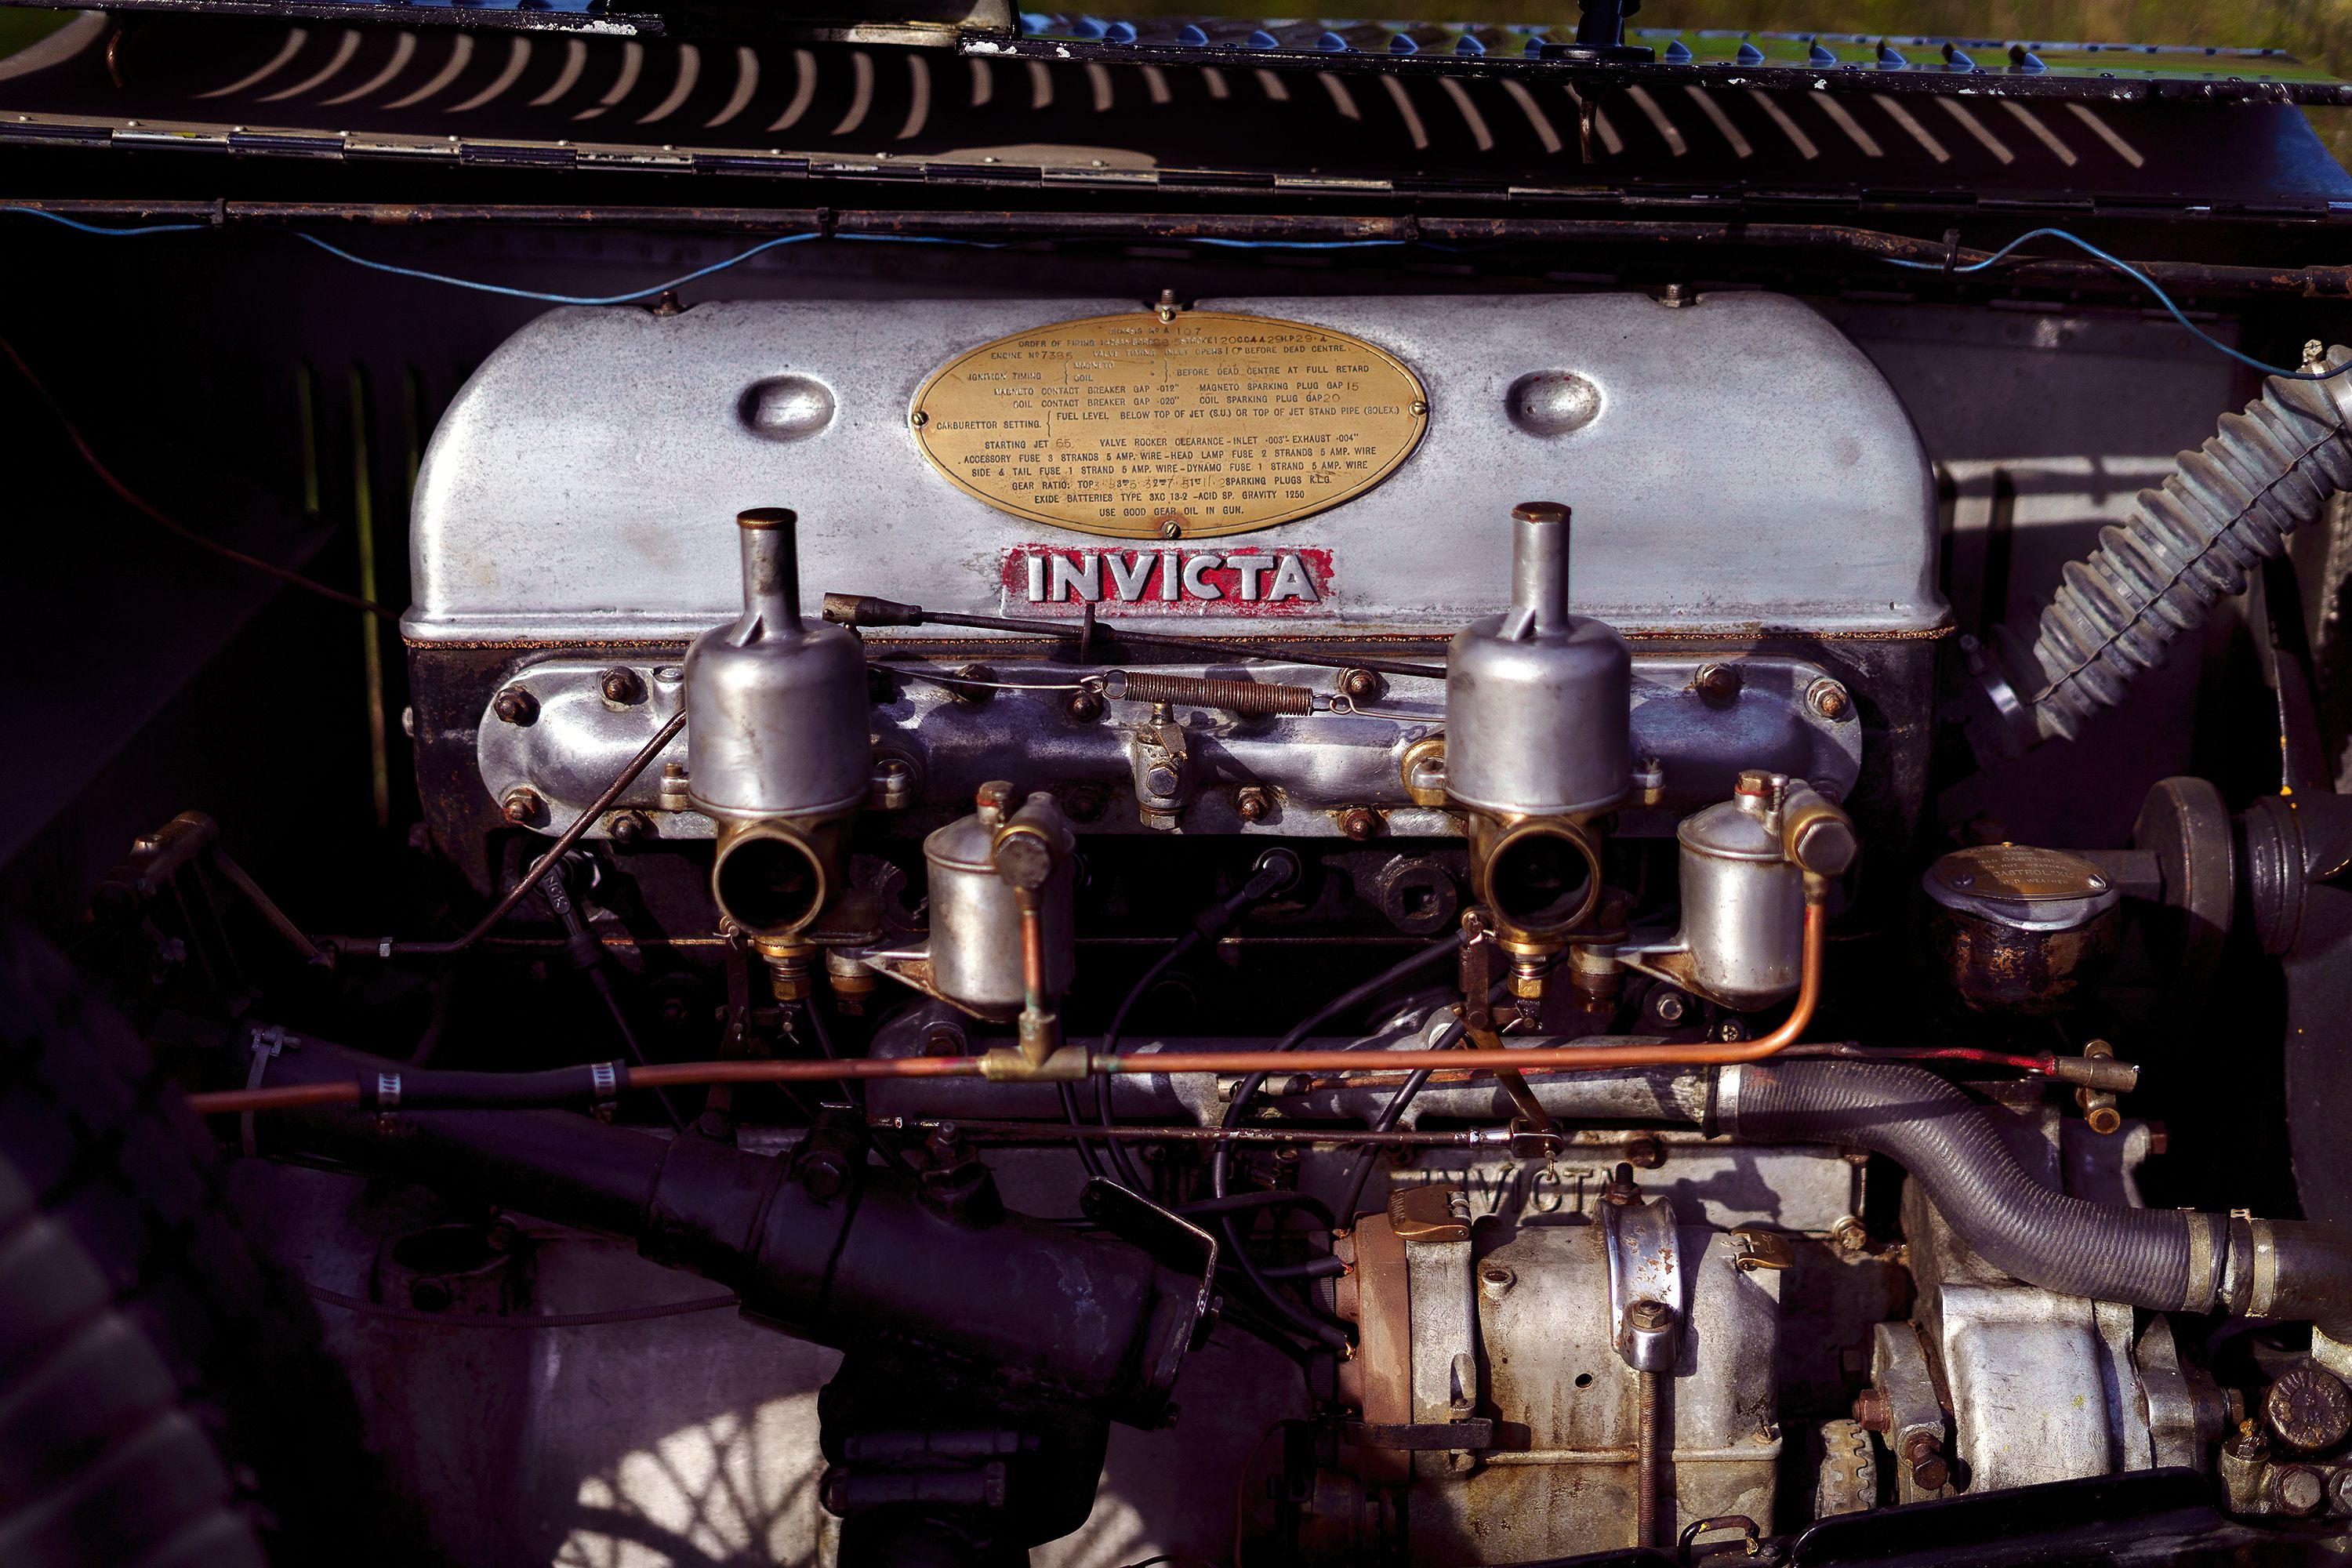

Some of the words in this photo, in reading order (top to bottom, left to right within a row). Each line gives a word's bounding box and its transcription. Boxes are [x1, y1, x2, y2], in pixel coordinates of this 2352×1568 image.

[968, 372, 1007, 381] IGNITION
[1176, 368, 1209, 376] BEFORE
[1217, 367, 1240, 376] DEAD
[1247, 366, 1280, 375] CENTRE
[1336, 365, 1370, 373] RETARD
[994, 387, 1034, 396] MAGNETO
[1041, 387, 1080, 395] CONTACT
[1087, 385, 1126, 394] BREAKER
[1133, 385, 1150, 394] GAP
[1199, 383, 1240, 391] MAGNETO
[1247, 382, 1288, 390] SPARKING
[1296, 381, 1319, 390] PLUG
[1327, 381, 1343, 390] GAP
[1013, 400, 1035, 408] COIL
[1041, 399, 1080, 408] CONTACT
[1087, 398, 1126, 407] BREAKER
[1133, 397, 1150, 406] GAP
[1199, 396, 1219, 405] COIL
[1226, 395, 1268, 404] SPARKING
[1276, 394, 1298, 403] PLUG
[1305, 394, 1323, 402] GAP
[1056, 412, 1079, 420] FUEL
[1082, 412, 1109, 420] LEVEL
[1120, 411, 1150, 419] BELOW
[1154, 410, 1171, 419] TOP
[1174, 409, 1187, 418] OF
[1189, 409, 1205, 418] JET
[1236, 408, 1248, 417] OR
[1254, 408, 1269, 416] TOP
[1273, 408, 1285, 416] OF
[1289, 407, 1305, 416] JET
[1308, 407, 1337, 416] STAND
[1341, 406, 1360, 415] PIPE
[936, 421, 997, 430] CARBURETTOR
[985, 440, 1026, 449] STARTING
[1033, 440, 1049, 448] JET
[1099, 438, 1127, 448] VALVE
[1134, 437, 1167, 446] ROCKER
[1174, 437, 1225, 446] CLEARANCE
[1233, 436, 1258, 445] INLET
[1293, 434, 1330, 443] EXHAUST
[964, 454, 1011, 463] ACCESSORY
[1018, 454, 1040, 463] FUSE
[1061, 453, 1099, 462] STRANDS
[1141, 452, 1162, 460] WIRE
[1201, 450, 1224, 459] LAMP
[1232, 449, 1254, 459] FUSE
[1261, 449, 1267, 458] 2
[1275, 448, 1312, 457] STRANDS
[1320, 448, 1326, 456] 5
[1354, 447, 1377, 456] WIRE
[971, 468, 990, 477] SIDE
[999, 468, 1005, 477] &
[1012, 467, 1031, 476] TAIL
[1081, 466, 1114, 475] STRAND
[1156, 464, 1178, 473] WIRE
[1187, 463, 1221, 473] DYNAMO
[1229, 463, 1251, 472] FUSE
[1346, 460, 1368, 470] WIRE
[1012, 481, 1034, 490] GEAR
[1077, 480, 1094, 489] TOP
[1225, 477, 1266, 486] SPARKING
[1274, 476, 1301, 485] PLUGS
[1034, 495, 1059, 503] EXIDE
[1067, 494, 1112, 503] BATTERIES
[1121, 493, 1142, 502] TYPE
[1149, 492, 1166, 502] 3XC
[1242, 491, 1277, 499] GRAVITY
[1285, 490, 1305, 499] 1250
[1099, 508, 1116, 517] USE
[1154, 507, 1176, 516] GEAR
[1184, 506, 1199, 515] OIL
[1027, 552, 1322, 603] INVICTA
